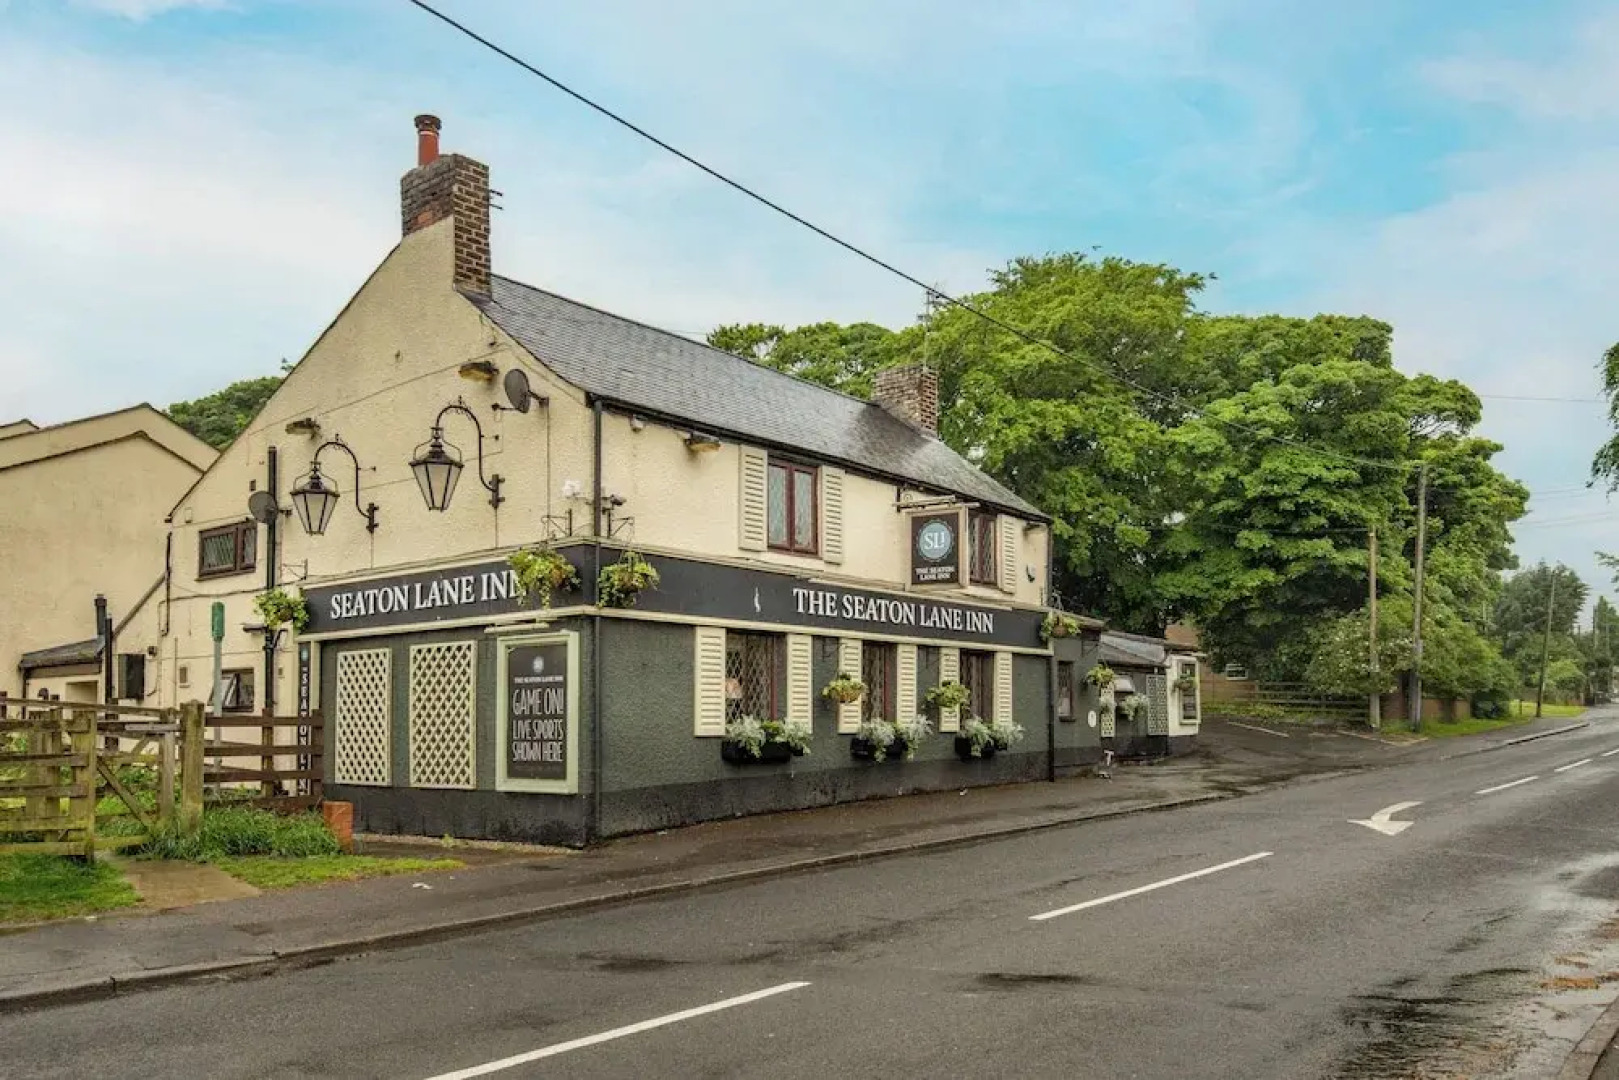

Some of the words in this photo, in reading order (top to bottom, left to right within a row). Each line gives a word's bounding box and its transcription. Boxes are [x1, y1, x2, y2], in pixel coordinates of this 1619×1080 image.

[330, 584, 409, 619] SEATON
[414, 575, 475, 610] LANE
[793, 588, 838, 617] THE
[842, 594, 915, 626] SEATON
[920, 604, 963, 631] LANE
[966, 610, 994, 634] INN
[512, 688, 542, 715] GAME
[543, 687, 564, 715] ON!
[512, 719, 532, 740] LIVE
[532, 718, 564, 740] SPORTS
[512, 742, 542, 762] SHOWN
[542, 741, 564, 762] HERE
